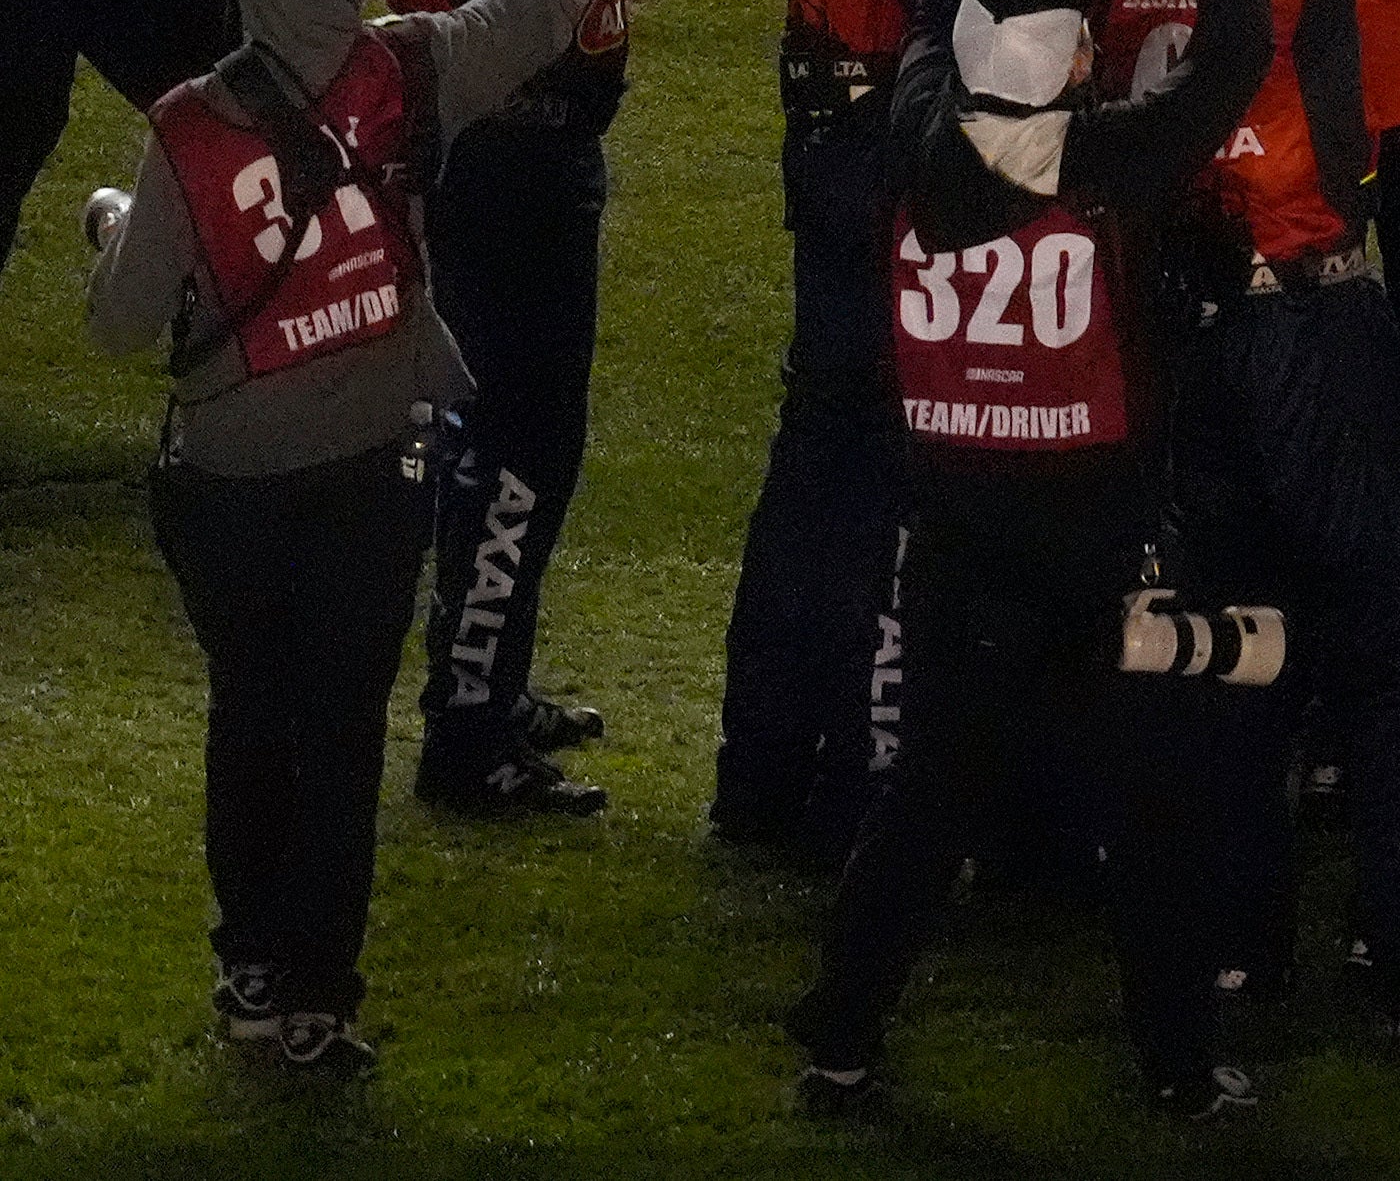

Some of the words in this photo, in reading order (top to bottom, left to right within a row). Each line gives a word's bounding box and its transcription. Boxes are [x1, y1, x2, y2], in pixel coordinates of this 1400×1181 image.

[277, 284, 400, 352] TEAM/DR
[899, 228, 1096, 349] 320
[902, 398, 1091, 438] TEAM/DRIVER
[446, 467, 537, 709] AXALTA
[868, 526, 910, 771] ALTA
